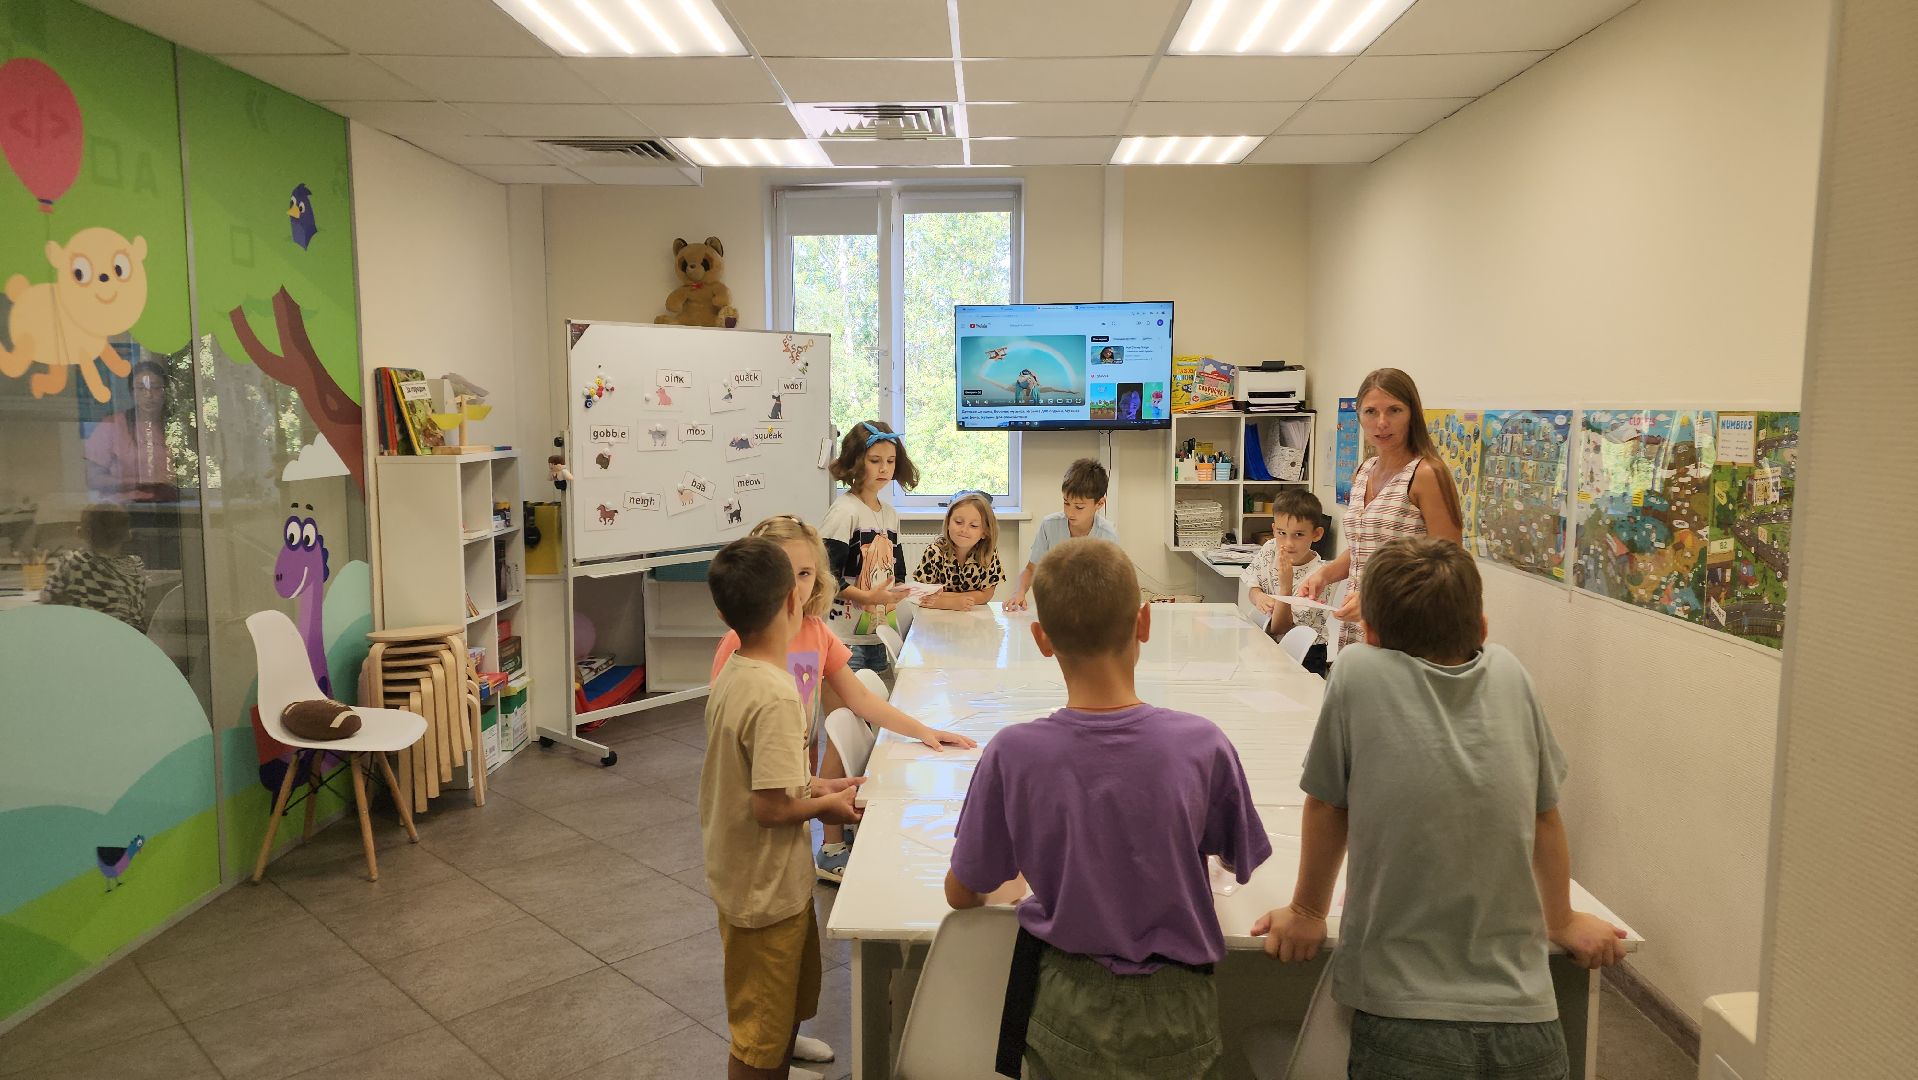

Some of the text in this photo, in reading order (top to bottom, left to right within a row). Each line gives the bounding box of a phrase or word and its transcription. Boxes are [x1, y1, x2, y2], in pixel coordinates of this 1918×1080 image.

[664, 373, 685, 384] oink
[734, 372, 759, 384] quack
[783, 381, 803, 390] woof
[1629, 416, 1656, 427] CLOES
[1721, 419, 1752, 430] NUMBERS
[686, 428, 706, 436] moo
[754, 430, 783, 441] squeak
[691, 478, 706, 492] baa
[737, 478, 761, 488] meow
[629, 496, 655, 508] neigh
